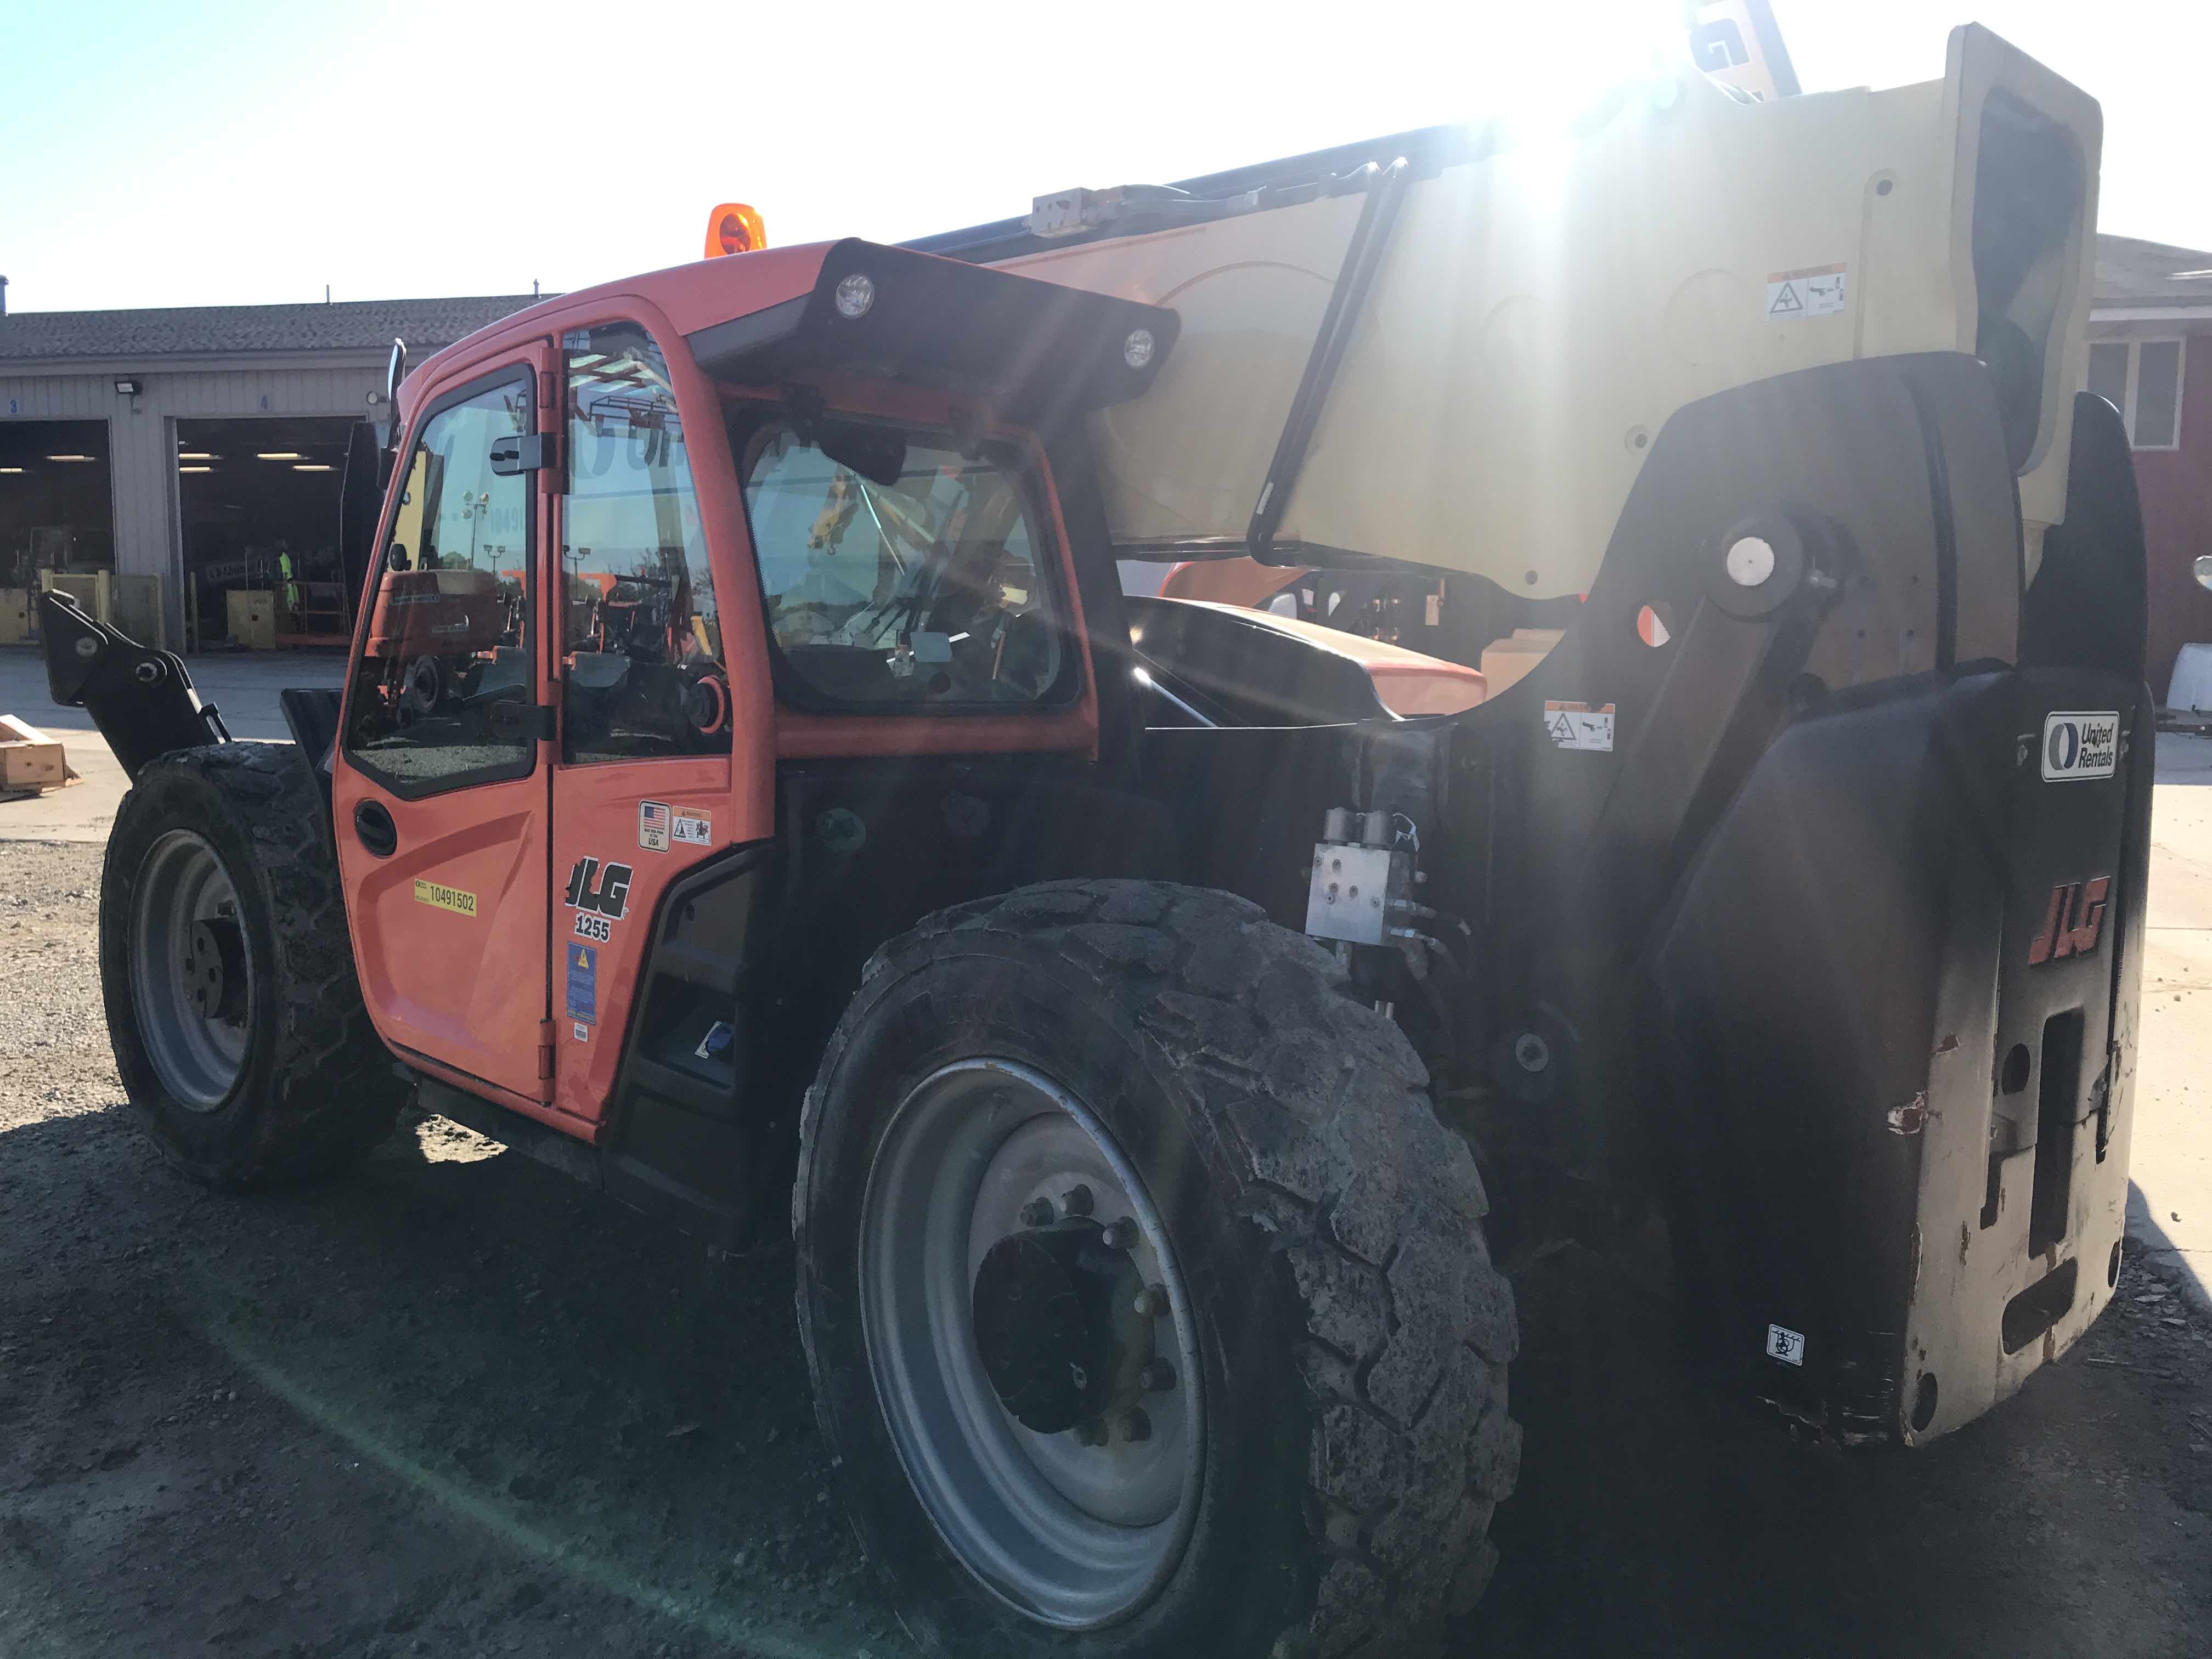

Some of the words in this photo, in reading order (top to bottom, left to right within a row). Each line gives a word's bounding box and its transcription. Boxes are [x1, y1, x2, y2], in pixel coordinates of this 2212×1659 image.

[2081, 723, 2114, 746] United
[2078, 746, 2113, 769] Rentals
[648, 838, 659, 847] USA
[431, 886, 473, 911] 10491502
[565, 856, 633, 919] JLG
[575, 915, 610, 940] 1255
[2028, 876, 2111, 965] JLG
